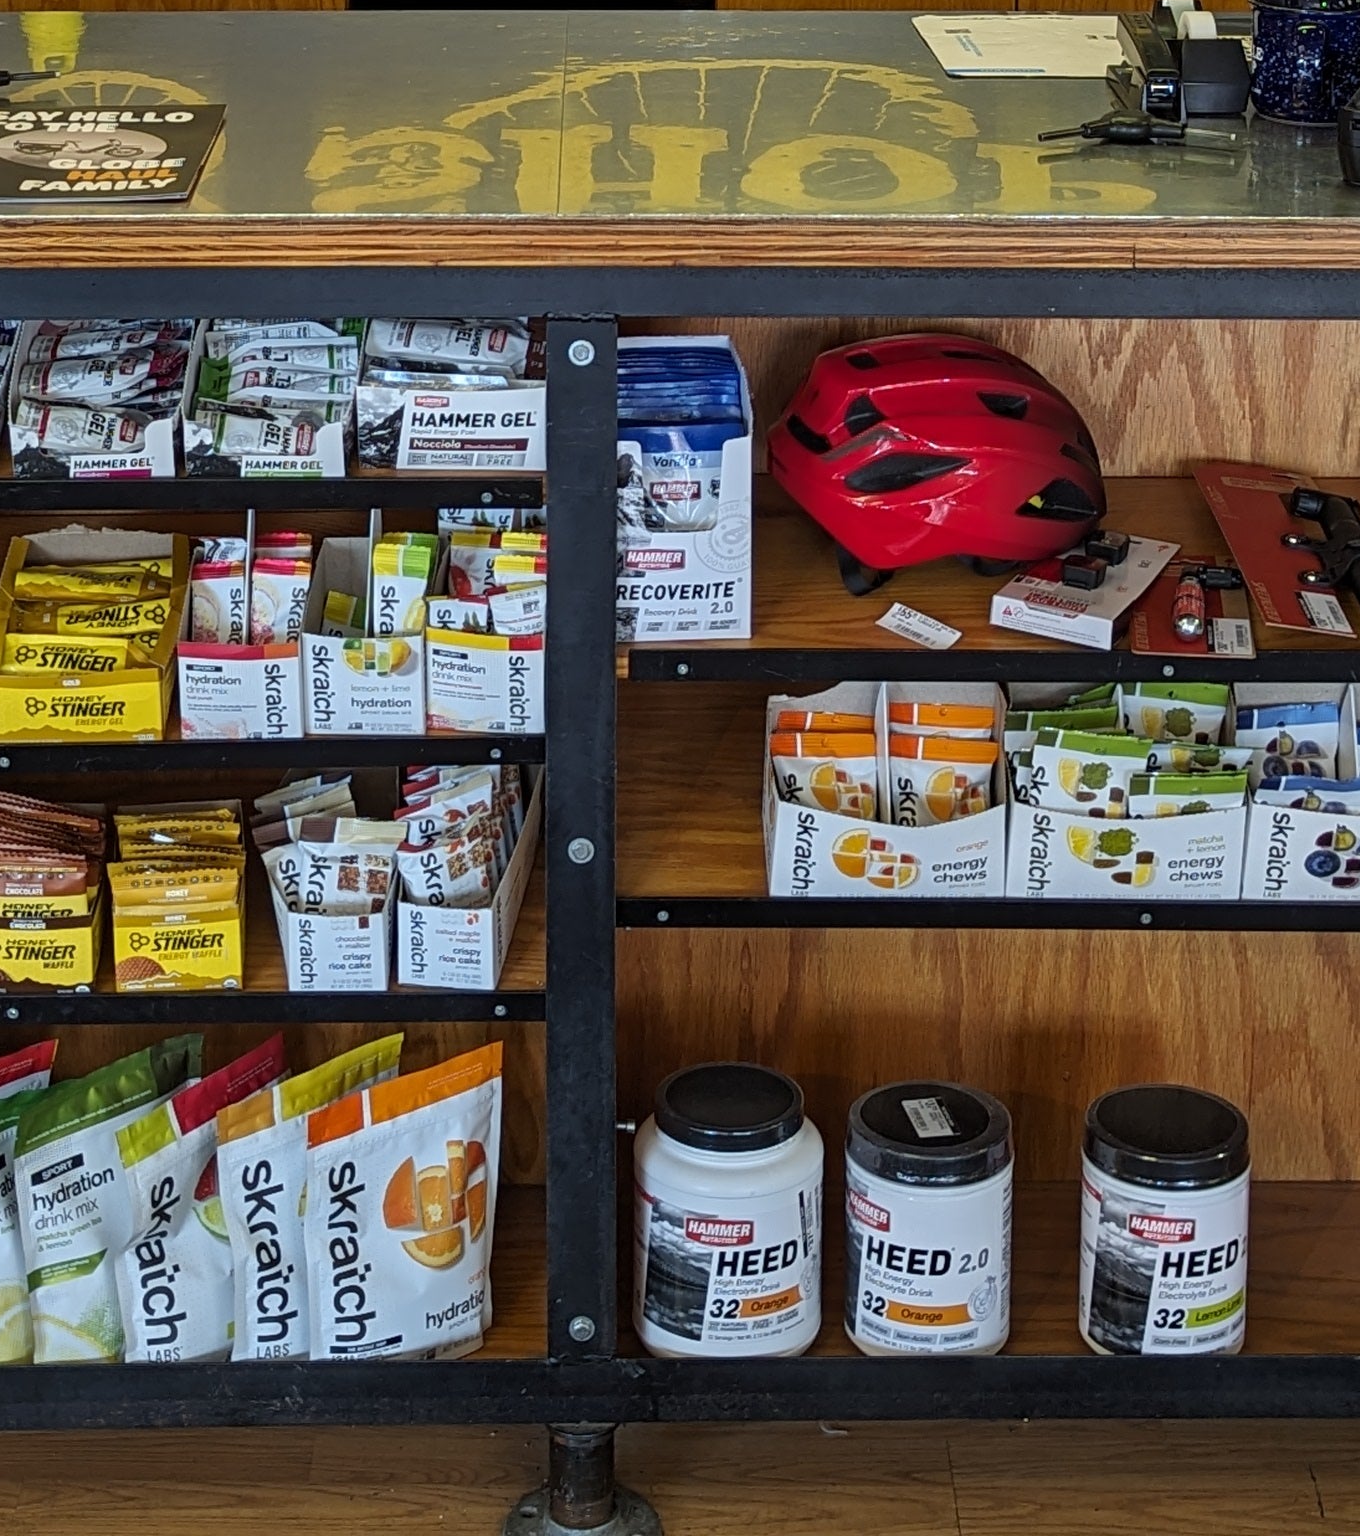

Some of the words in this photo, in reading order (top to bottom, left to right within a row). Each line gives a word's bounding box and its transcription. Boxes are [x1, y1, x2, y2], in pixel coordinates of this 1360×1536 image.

[67, 110, 195, 123] HELLO
[48, 157, 187, 170] GLOBE
[66, 169, 178, 181] HAUL
[17, 179, 178, 192] FAMILY
[411, 412, 495, 430] HAMMER
[499, 409, 536, 429] GEL
[412, 438, 462, 449] Nocciola
[616, 580, 735, 601] RECOVERITE
[710, 601, 734, 616] 2.0
[186, 674, 242, 688] hydration
[50, 694, 107, 704] HONEY
[350, 696, 412, 711] hydration
[47, 700, 126, 720] STINGER
[932, 855, 989, 876] energy
[1167, 855, 1225, 873] energy
[933, 869, 988, 885] chews
[1168, 867, 1223, 883] chews
[151, 932, 224, 951] STINGER
[154, 928, 207, 938] HONEY
[2, 944, 76, 960] STINGER
[452, 948, 481, 959] crispy
[43, 961, 75, 969] WAFFLE
[33, 1167, 115, 1213] hydration
[35, 1203, 73, 1231] drink
[75, 1198, 100, 1217] mix
[1130, 1217, 1194, 1235] HAMMER
[241, 1160, 299, 1344] skratch
[328, 1161, 376, 1344] skratch
[716, 1240, 798, 1277] HEED
[866, 1235, 952, 1277] HEED
[958, 1248, 990, 1274] 2.0
[1160, 1238, 1239, 1278] HEED
[709, 1298, 740, 1320] 32
[862, 1290, 887, 1317] 32
[900, 1306, 944, 1322] Orange
[1153, 1308, 1186, 1330] 32
[256, 1342, 291, 1359] LABS
